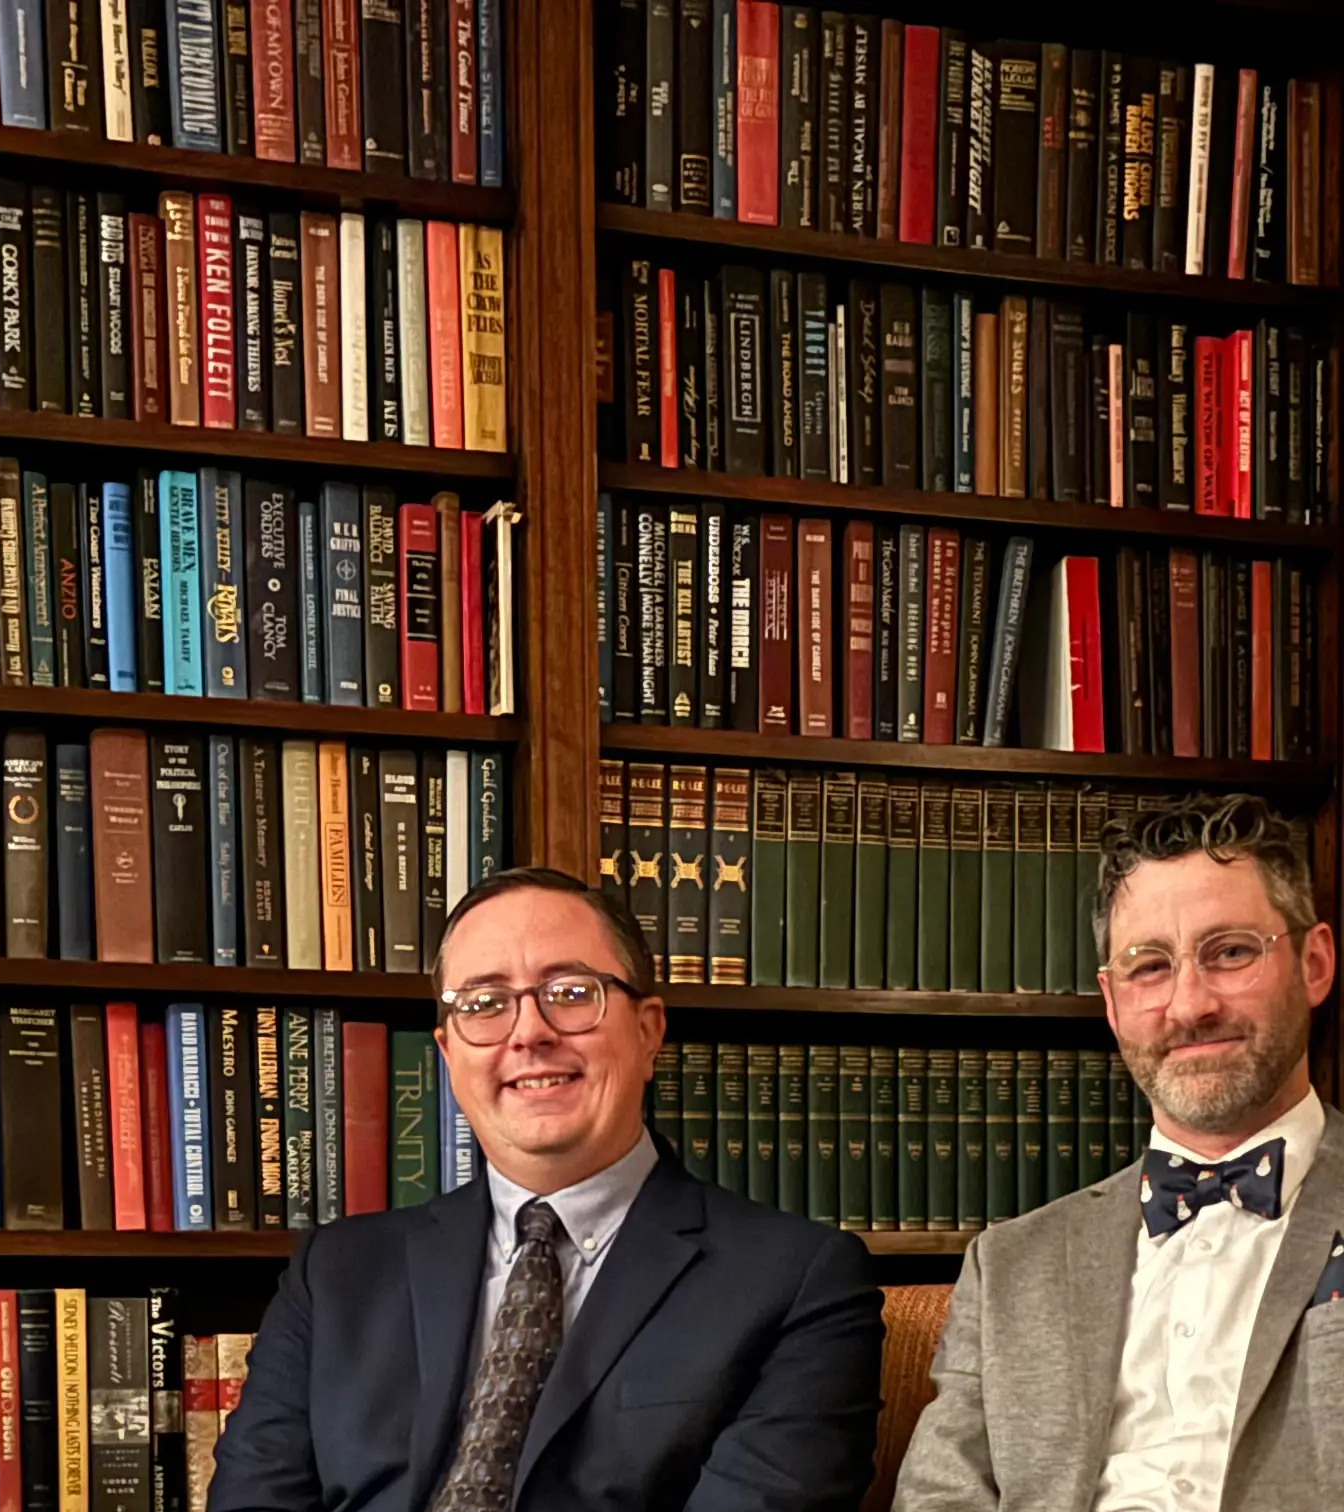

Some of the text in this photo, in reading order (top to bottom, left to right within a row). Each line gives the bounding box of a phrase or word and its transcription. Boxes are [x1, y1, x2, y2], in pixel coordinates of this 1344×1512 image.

[457, 19, 471, 47] The
[269, 62, 284, 110] OWN
[459, 92, 473, 135] Times
[968, 48, 984, 216] HORNET FLIGHT
[245, 245, 259, 290] HONOR
[316, 266, 325, 282] THE
[470, 272, 498, 291] THE
[476, 251, 492, 269] AS
[246, 291, 260, 336] AMONG
[273, 279, 295, 366] Hornet's Nest
[316, 284, 326, 306] DARK
[317, 309, 326, 328] SIDE
[4, 307, 21, 352] PARK
[206, 247, 232, 401] KEN FOLLETT
[318, 331, 327, 342] OF
[467, 314, 503, 334] FLIES
[804, 310, 826, 376] TARGET
[248, 338, 261, 392] THIEVES
[633, 292, 651, 416] MORTAL FEAR
[739, 320, 753, 416] LINDBERGH
[781, 332, 792, 447] THE ROAD AHEAD
[31, 483, 45, 496] A
[89, 497, 99, 524] The
[169, 486, 180, 528] GENTLE
[215, 485, 230, 526] KITTY
[216, 527, 231, 573] KELLEY
[260, 501, 274, 559] ORDERS
[271, 492, 285, 569] EXECUTIVE
[369, 504, 383, 564] BALDACCI
[382, 516, 394, 554] DAVID
[638, 513, 652, 586] CONNELLY
[654, 522, 665, 587] MICHAEL
[1014, 544, 1028, 567] THE
[708, 516, 720, 604] UNDERBOSS
[59, 558, 76, 620] ANZIO
[370, 585, 384, 625] FAITH
[383, 583, 395, 629] SAVING
[618, 567, 630, 651] Citizen Coors
[677, 560, 692, 667] THE KILL ARTIST
[731, 577, 750, 607] THE
[942, 540, 956, 656] In Retrospect
[1007, 568, 1025, 624] BRETHREN
[262, 601, 275, 661] CLANCY
[274, 615, 286, 649] TOM
[641, 594, 655, 705] MORE THAN NIGHT
[654, 594, 665, 667] A DARKNESS
[707, 617, 719, 646] Peter
[811, 570, 822, 682] THE DARK SIDE OF CAMELOT
[907, 602, 919, 651] BREAKING
[1002, 633, 1016, 665] JOHN
[253, 746, 263, 757] A
[253, 760, 266, 801] Traitor
[480, 758, 496, 842] Gail Godwin
[254, 818, 267, 868] Memory
[329, 827, 345, 903] FAMILIES
[289, 1012, 309, 1113] ANNE PERRY
[180, 1012, 204, 1197] DAVID BALDACCI TOTAL CONTROL
[257, 1006, 281, 1196] TONY HILLERMAN FINDING MOON
[324, 1010, 336, 1200] THE BRETHREN JOHN GRISHAM
[395, 1061, 425, 1190] TRINITY
[286, 1136, 300, 1199] GARDENS
[301, 1130, 312, 1206] BRUNSWICK
[150, 1297, 175, 1388] The Victors
[63, 1298, 81, 1496] SIDNEY SHELDON NOTHING LASTS FOREVER
